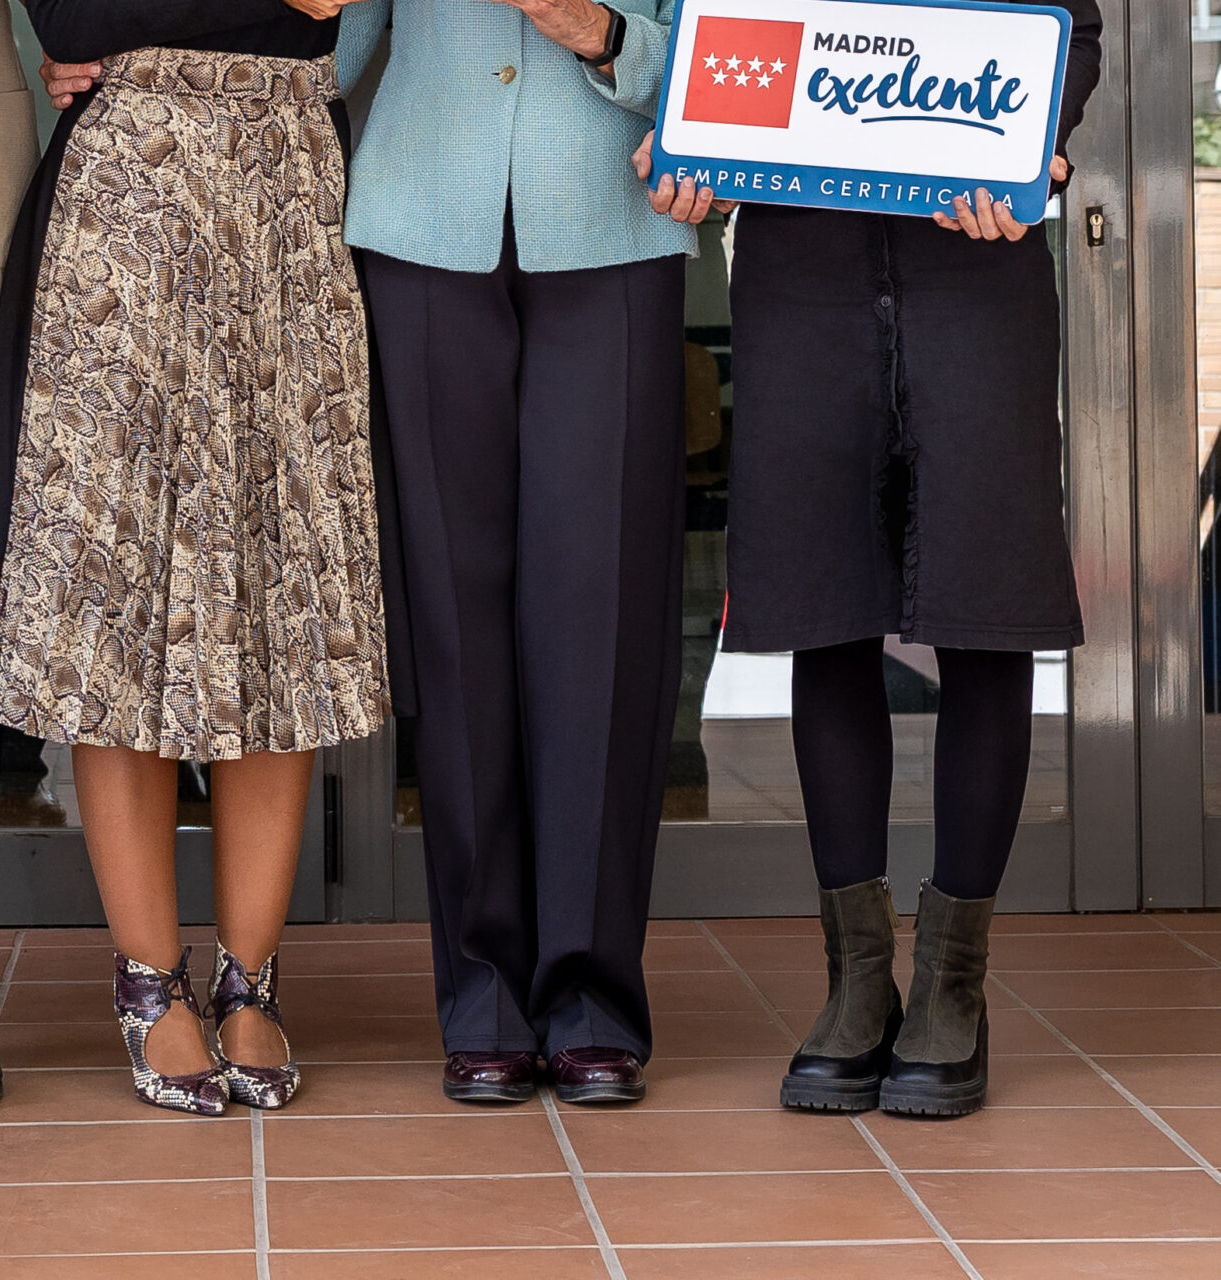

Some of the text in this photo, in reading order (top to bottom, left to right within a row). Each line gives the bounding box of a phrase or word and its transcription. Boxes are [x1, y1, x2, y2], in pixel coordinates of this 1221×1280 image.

[813, 32, 914, 57] MADRID
[807, 54, 1029, 120] excelente
[676, 167, 801, 192] EMPRESA
